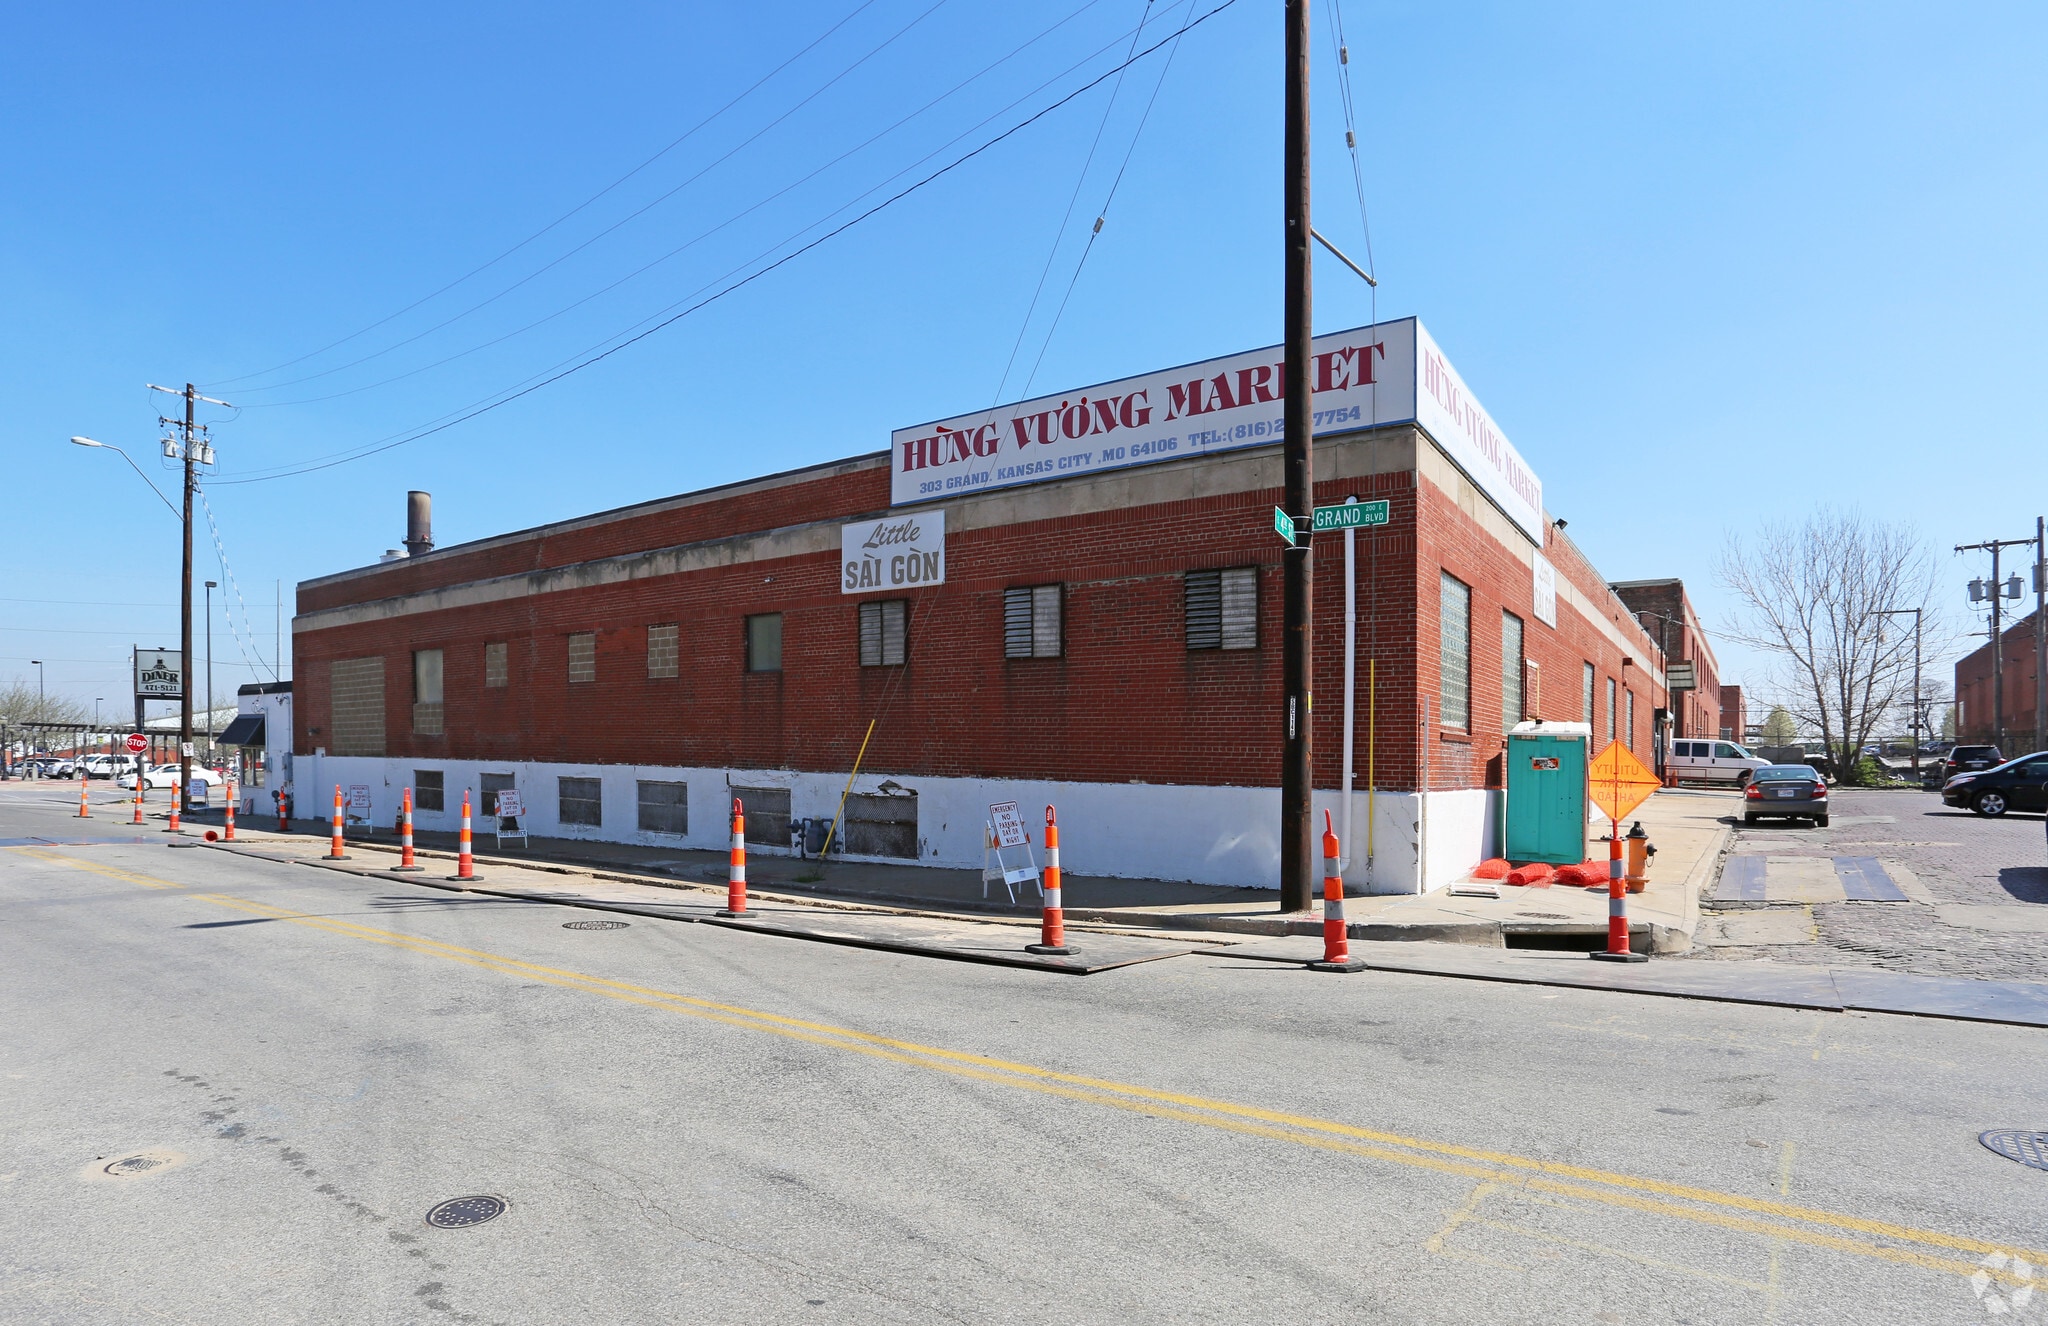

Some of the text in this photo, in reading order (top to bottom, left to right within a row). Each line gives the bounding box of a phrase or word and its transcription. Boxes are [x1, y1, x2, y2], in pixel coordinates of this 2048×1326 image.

[902, 421, 1001, 473] HÙNG
[919, 482, 943, 494] 303
[997, 459, 1054, 480] KANSAS
[1058, 452, 1093, 470] CITY
[1130, 437, 1178, 458] 64106
[1316, 508, 1361, 526] GRAND
[1365, 513, 1384, 522] BLVD
[862, 519, 921, 549] Little
[845, 547, 940, 589] SÀI GÒN
[142, 671, 179, 682] DINER
[127, 738, 147, 747] STOP
[992, 804, 1016, 814] EMERGENCY
[999, 820, 1018, 829] PARKING
[1005, 836, 1020, 844] NIGHT
